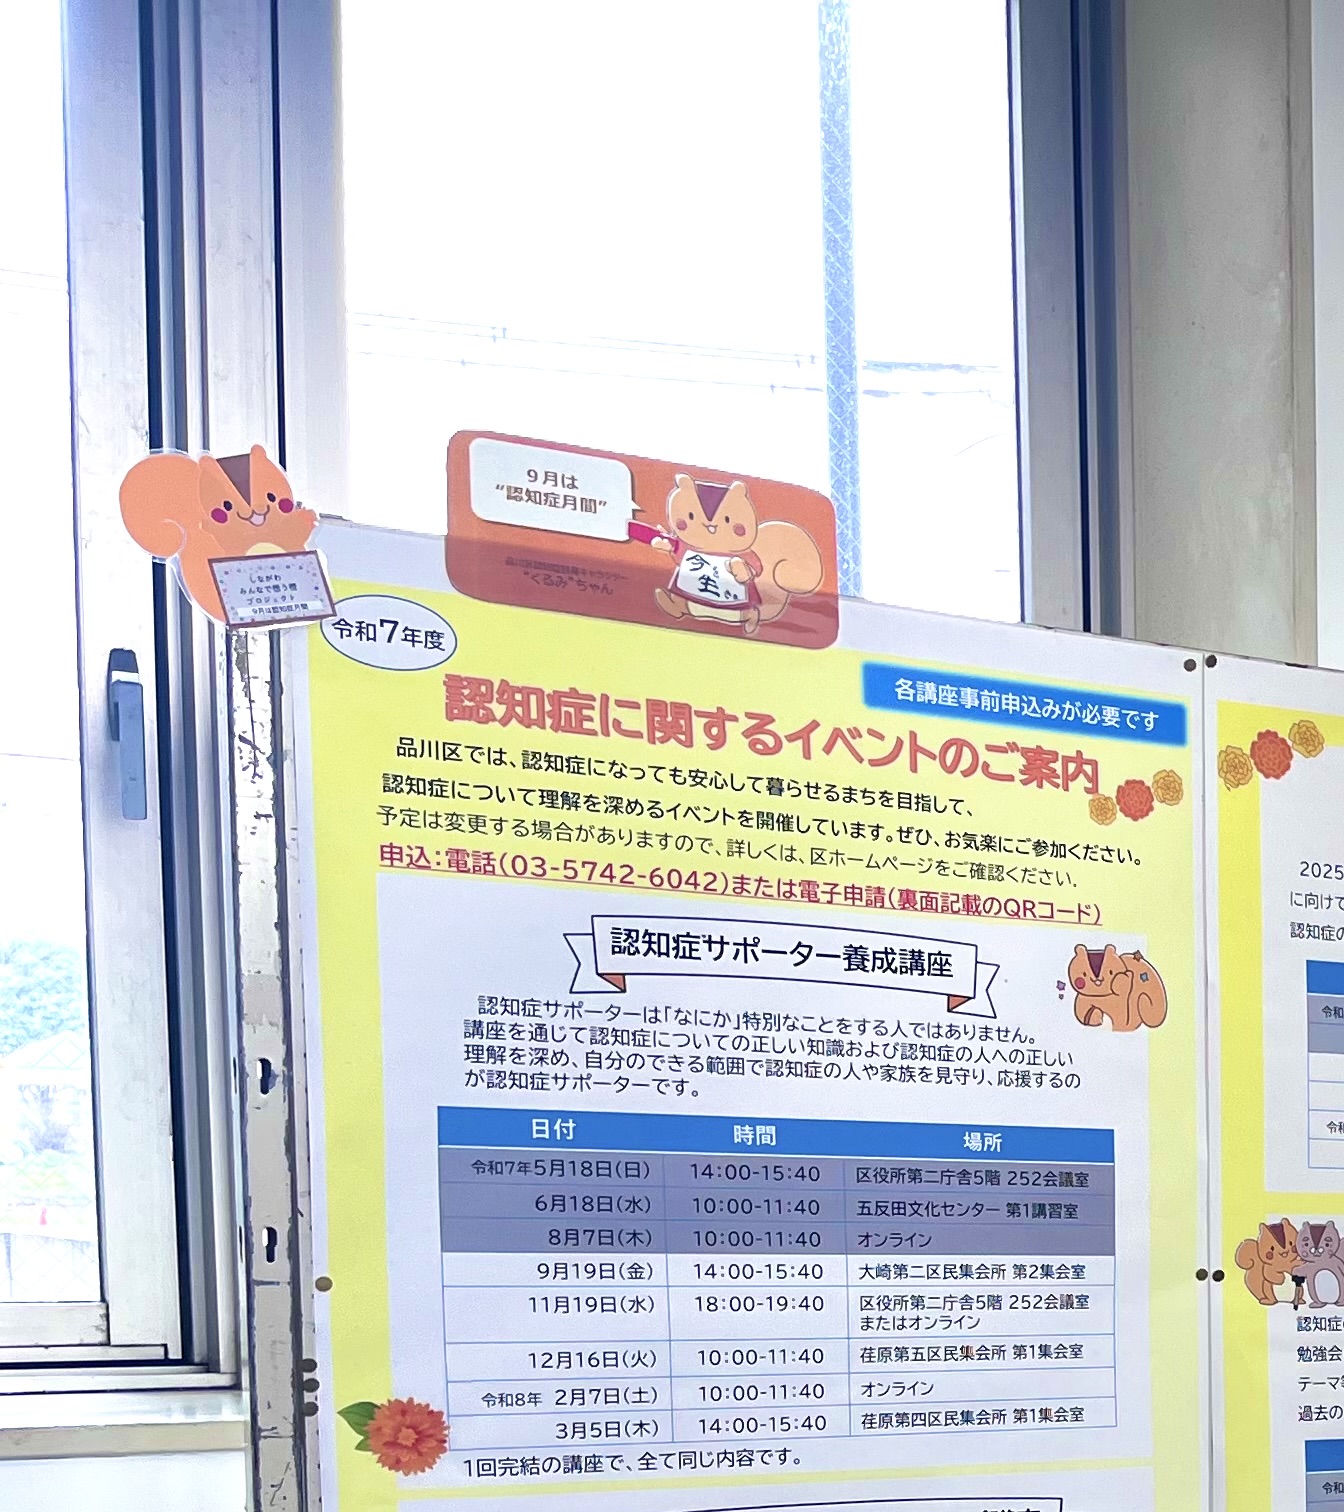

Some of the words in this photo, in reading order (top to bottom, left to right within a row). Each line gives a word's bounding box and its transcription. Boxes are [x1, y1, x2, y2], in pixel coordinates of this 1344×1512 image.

[527, 469, 579, 491] 9月は
[331, 618, 446, 652] 令和7年度
[894, 677, 1160, 733] 各講座事前申込みが必要です
[443, 673, 1100, 795] 認知症に関するイベントのご案内
[396, 736, 974, 818] 品川区では、認知症になっても安心して暮らせるまちを目指して、
[381, 772, 1142, 866] 認知症について理解を深めるイベントを開催しています。ぜひ、お気楽にご参加ください。
[375, 804, 1077, 888] 予定は変更する場合がありますので、詳しくは、区ホームページをご確認ください。
[610, 926, 954, 978] 認知症サポーター養成講座
[463, 1019, 1074, 1067] 講座を通じて認知症についての正しい知識および認知症の人への正しい
[477, 994, 1036, 1045] 認知症サポーターは「なにか」特別なことをする人ではありません。
[463, 1043, 1081, 1090] 理解を深め、自分のできる範囲で認知症の人や家族を見守り、応援するの
[463, 1069, 699, 1098] が認知症サポーターです。
[531, 1117, 576, 1140] 日付
[732, 1124, 777, 1147] 時間
[963, 1131, 1003, 1153] 場所
[470, 1159, 651, 1180] 令和7年5月18日(日)
[690, 1163, 821, 1183] 14:00-15:40
[856, 1167, 1001, 1187] 区役所第二庁舎5階
[1006, 1170, 1090, 1189] 252会議室
[463, 1447, 801, 1478] 1回完結の講座で、全て同じ内容です。
